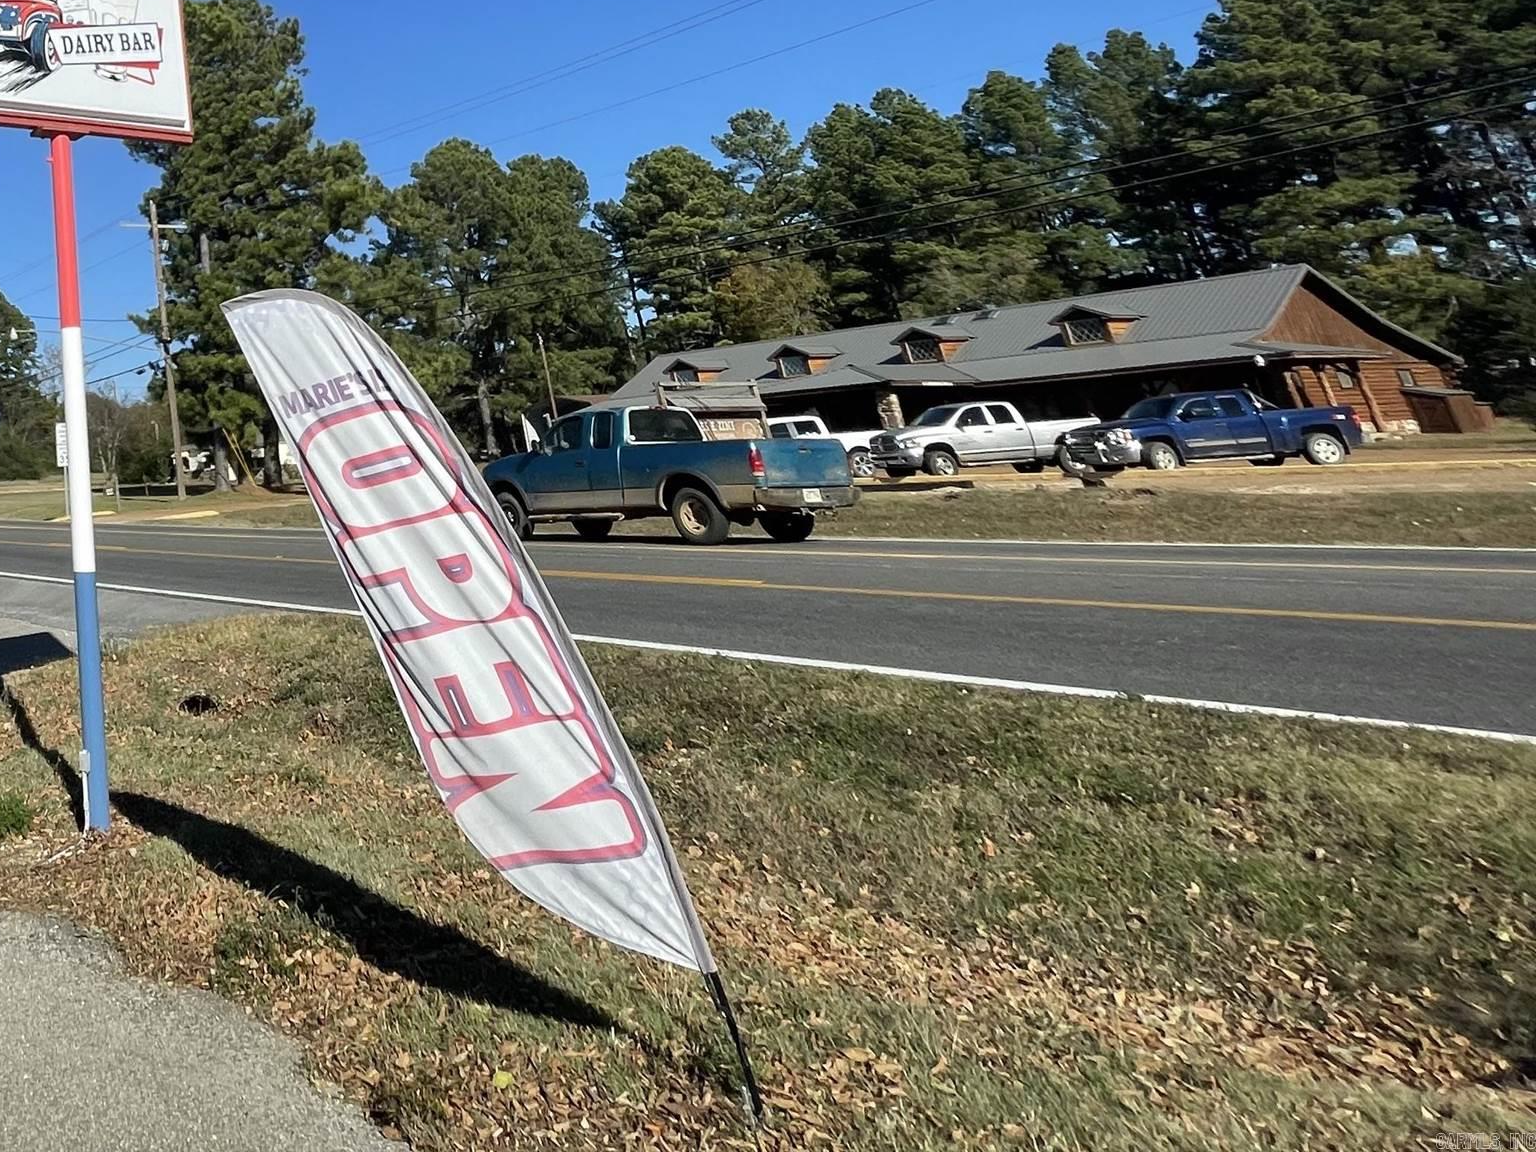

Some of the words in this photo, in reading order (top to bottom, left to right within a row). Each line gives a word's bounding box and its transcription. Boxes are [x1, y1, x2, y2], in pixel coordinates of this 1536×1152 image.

[61, 33, 114, 55] DAIRY
[120, 32, 156, 52] BAR
[297, 397, 648, 872] OPEN
